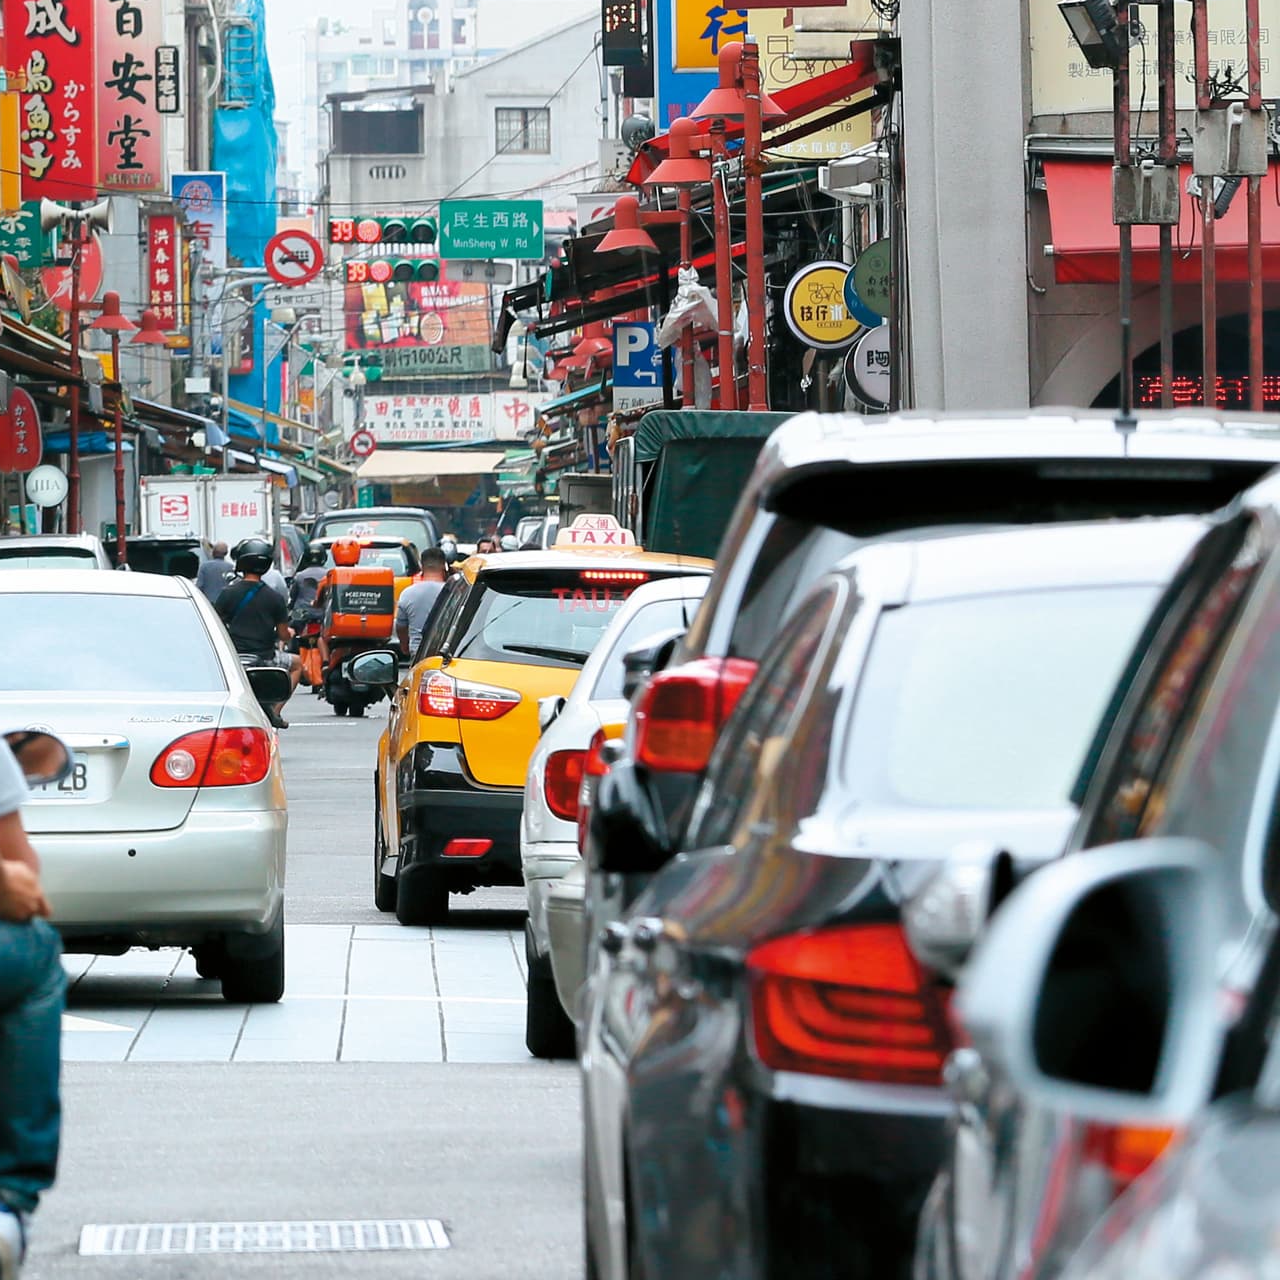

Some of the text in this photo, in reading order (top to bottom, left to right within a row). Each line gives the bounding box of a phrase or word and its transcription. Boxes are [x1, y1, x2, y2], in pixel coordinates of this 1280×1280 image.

[60, 79, 85, 169] からすみ
[332, 220, 353, 241] 39
[453, 211, 529, 229] 民生西路
[453, 238, 528, 250] MinSheng W Rd
[348, 263, 368, 282] 39
[617, 327, 649, 367] P
[503, 398, 529, 429] 中
[14, 403, 29, 455] からすみ
[568, 530, 626, 545] TAXI
